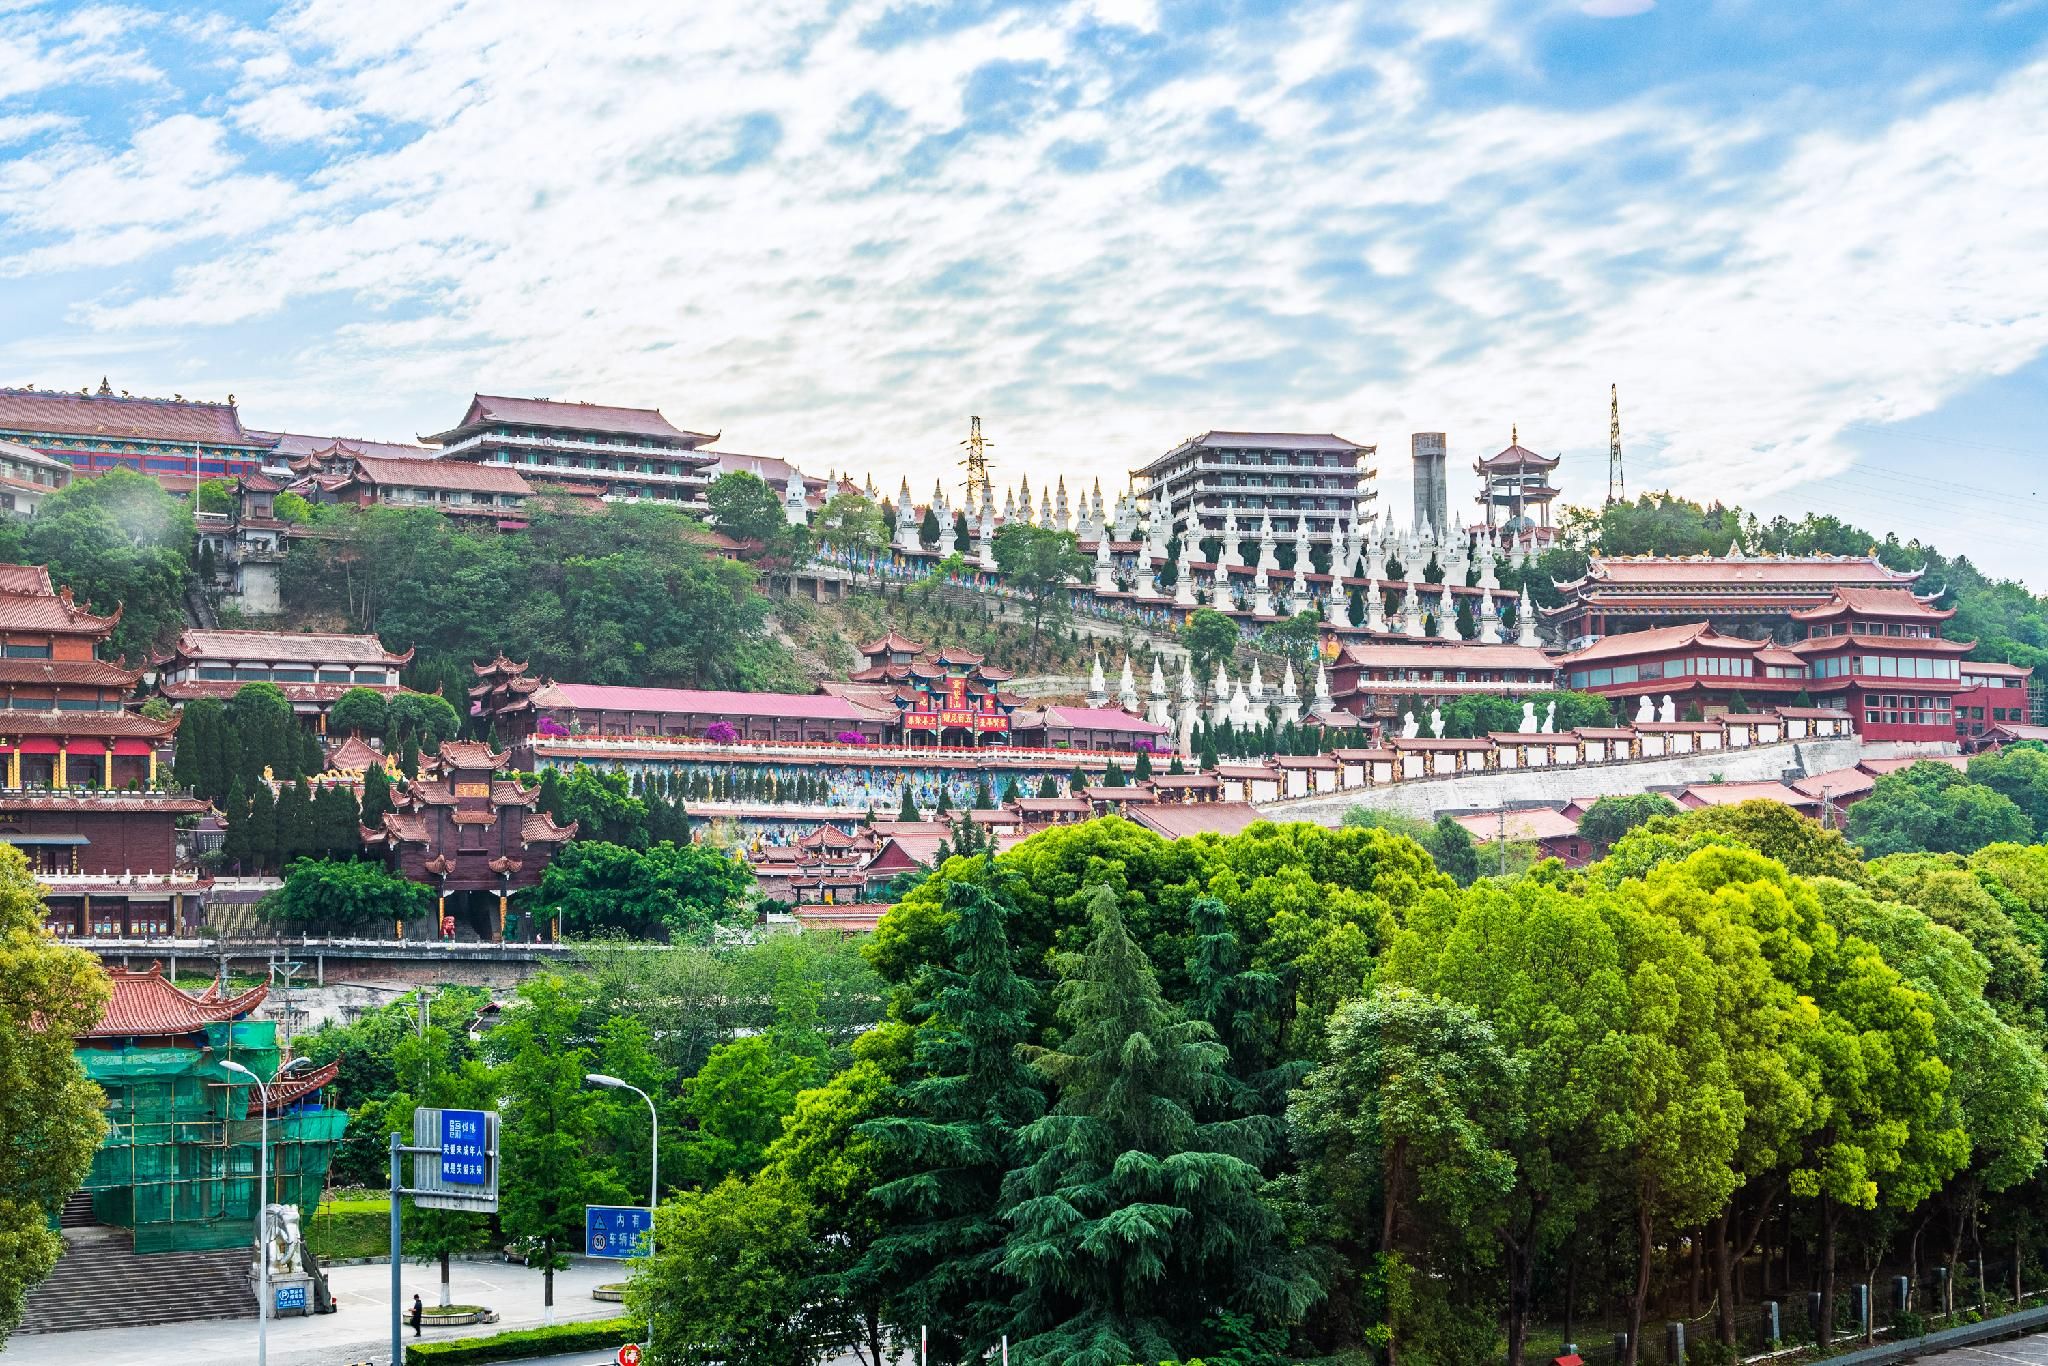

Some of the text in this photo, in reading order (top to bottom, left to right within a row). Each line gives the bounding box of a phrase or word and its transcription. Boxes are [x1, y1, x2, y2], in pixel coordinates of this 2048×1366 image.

[616, 1212, 640, 1228] 内有
[595, 1237, 604, 1247] 30
[609, 1232, 643, 1247] 车辆出
